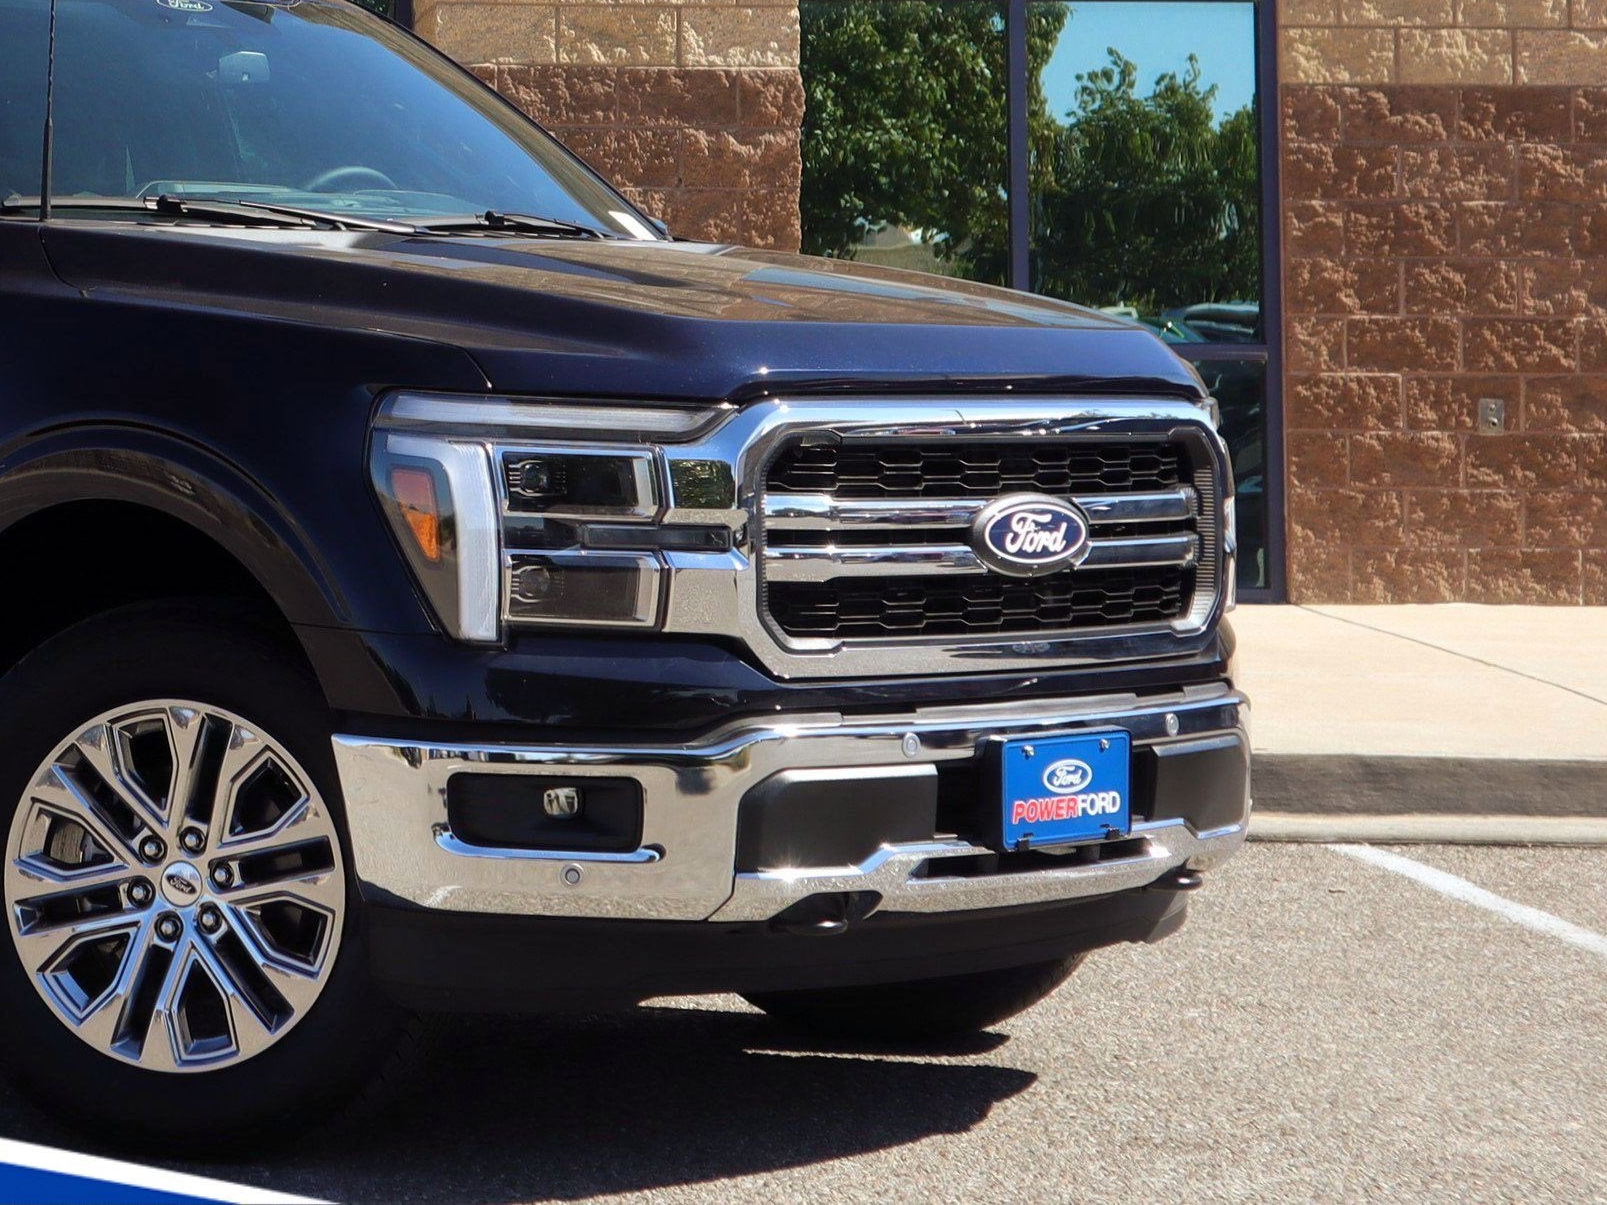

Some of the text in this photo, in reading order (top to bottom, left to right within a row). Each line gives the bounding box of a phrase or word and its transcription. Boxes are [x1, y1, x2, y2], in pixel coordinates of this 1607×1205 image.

[1005, 512, 1067, 553] Ford
[1052, 765, 1082, 787] Ford
[169, 876, 192, 893] Ford
